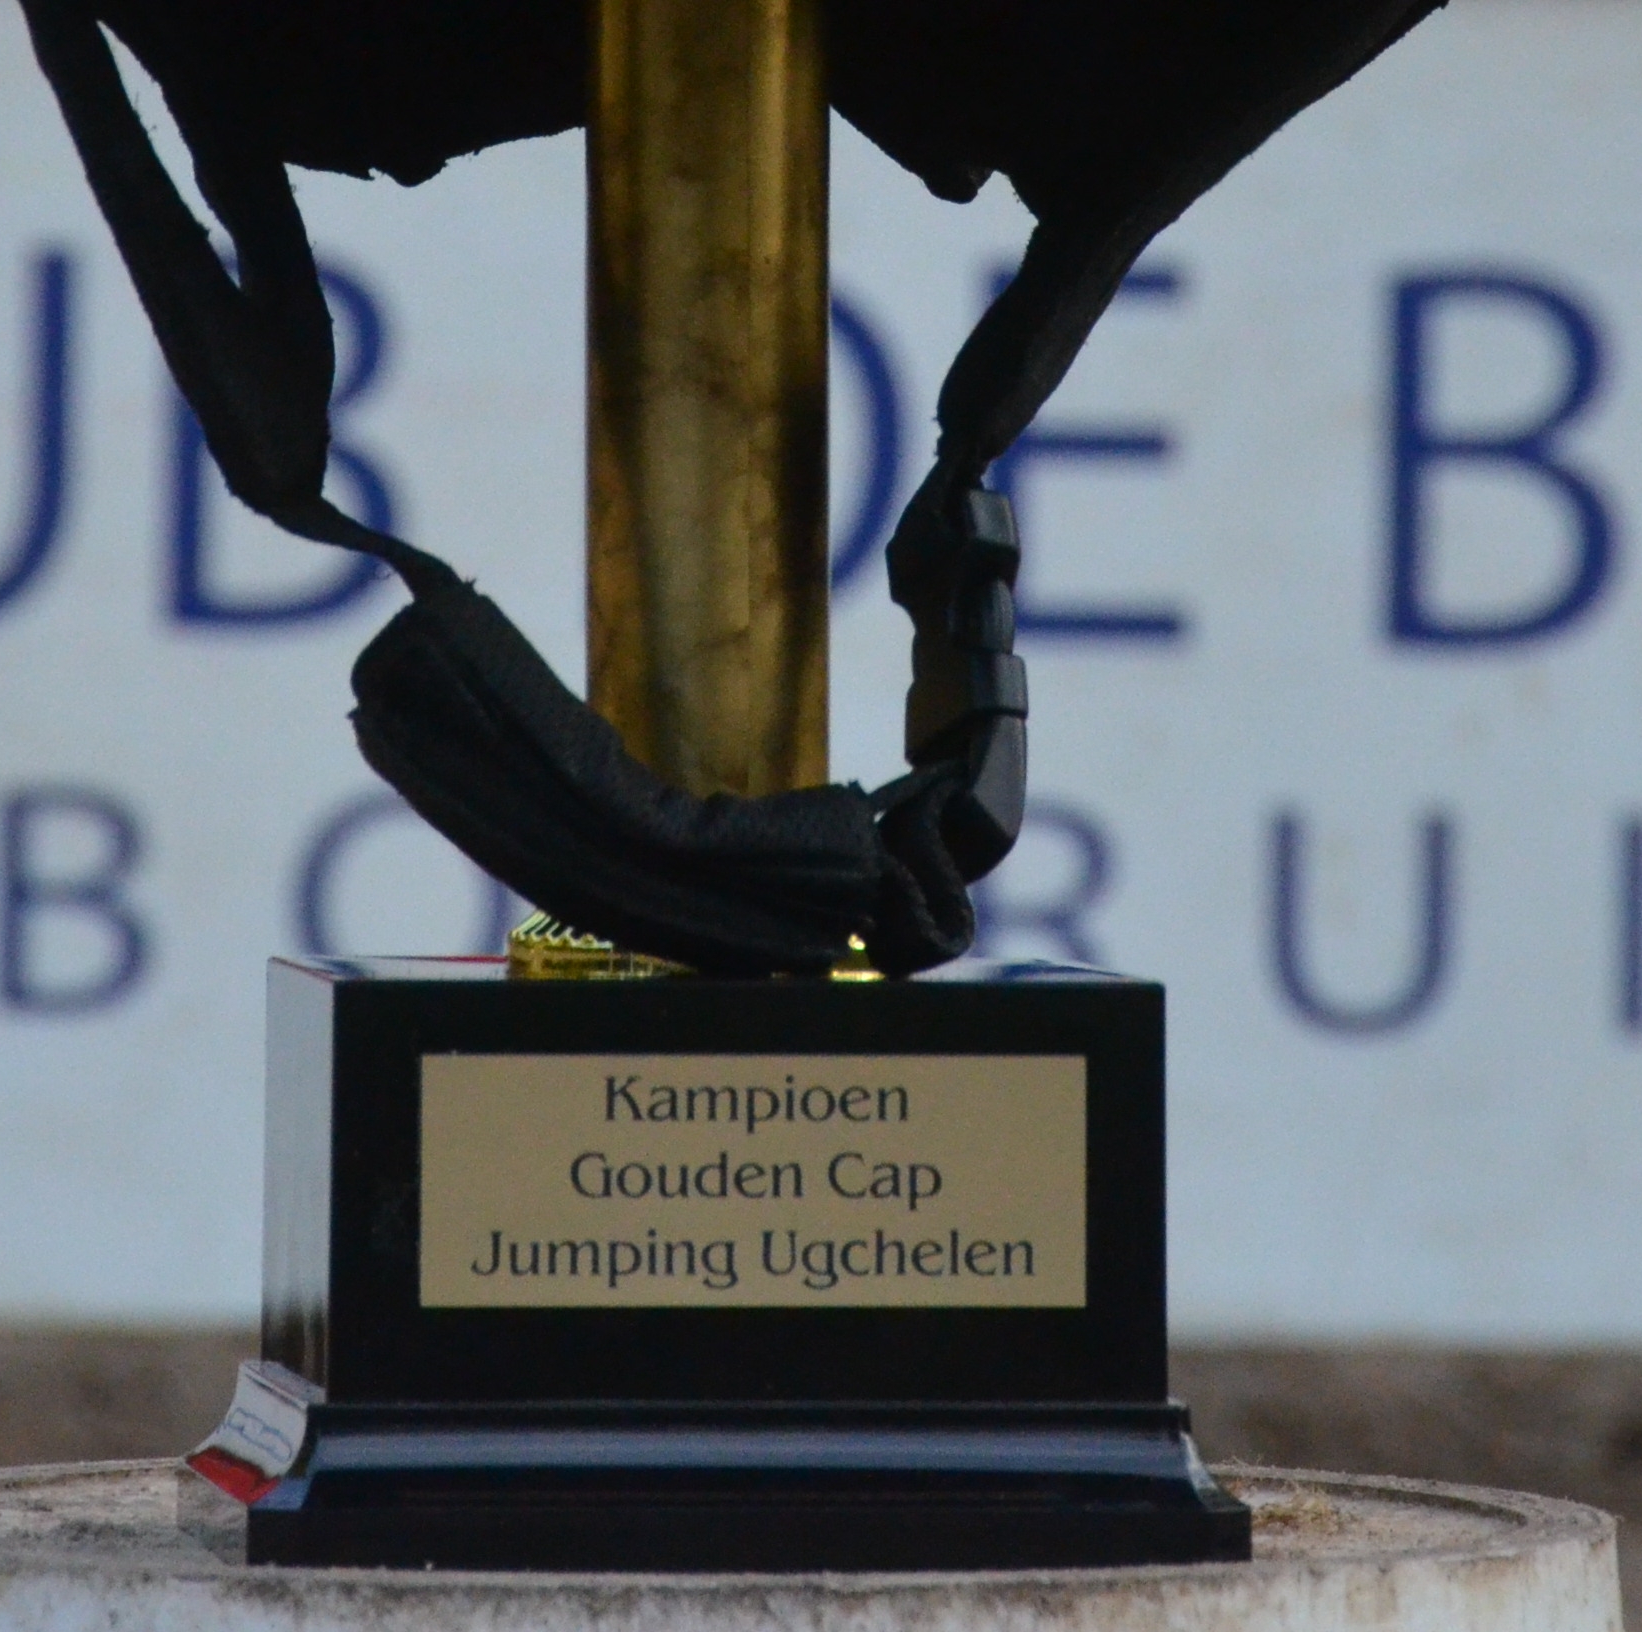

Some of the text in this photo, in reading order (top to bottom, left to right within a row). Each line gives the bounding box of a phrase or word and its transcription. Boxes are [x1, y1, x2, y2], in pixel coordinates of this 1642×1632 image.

[831, 258, 1189, 636] E
[603, 1073, 910, 1134] Kampioen
[569, 1151, 944, 1211] Gouden Cap
[469, 1228, 1036, 1290] Jumping Ugchelen
